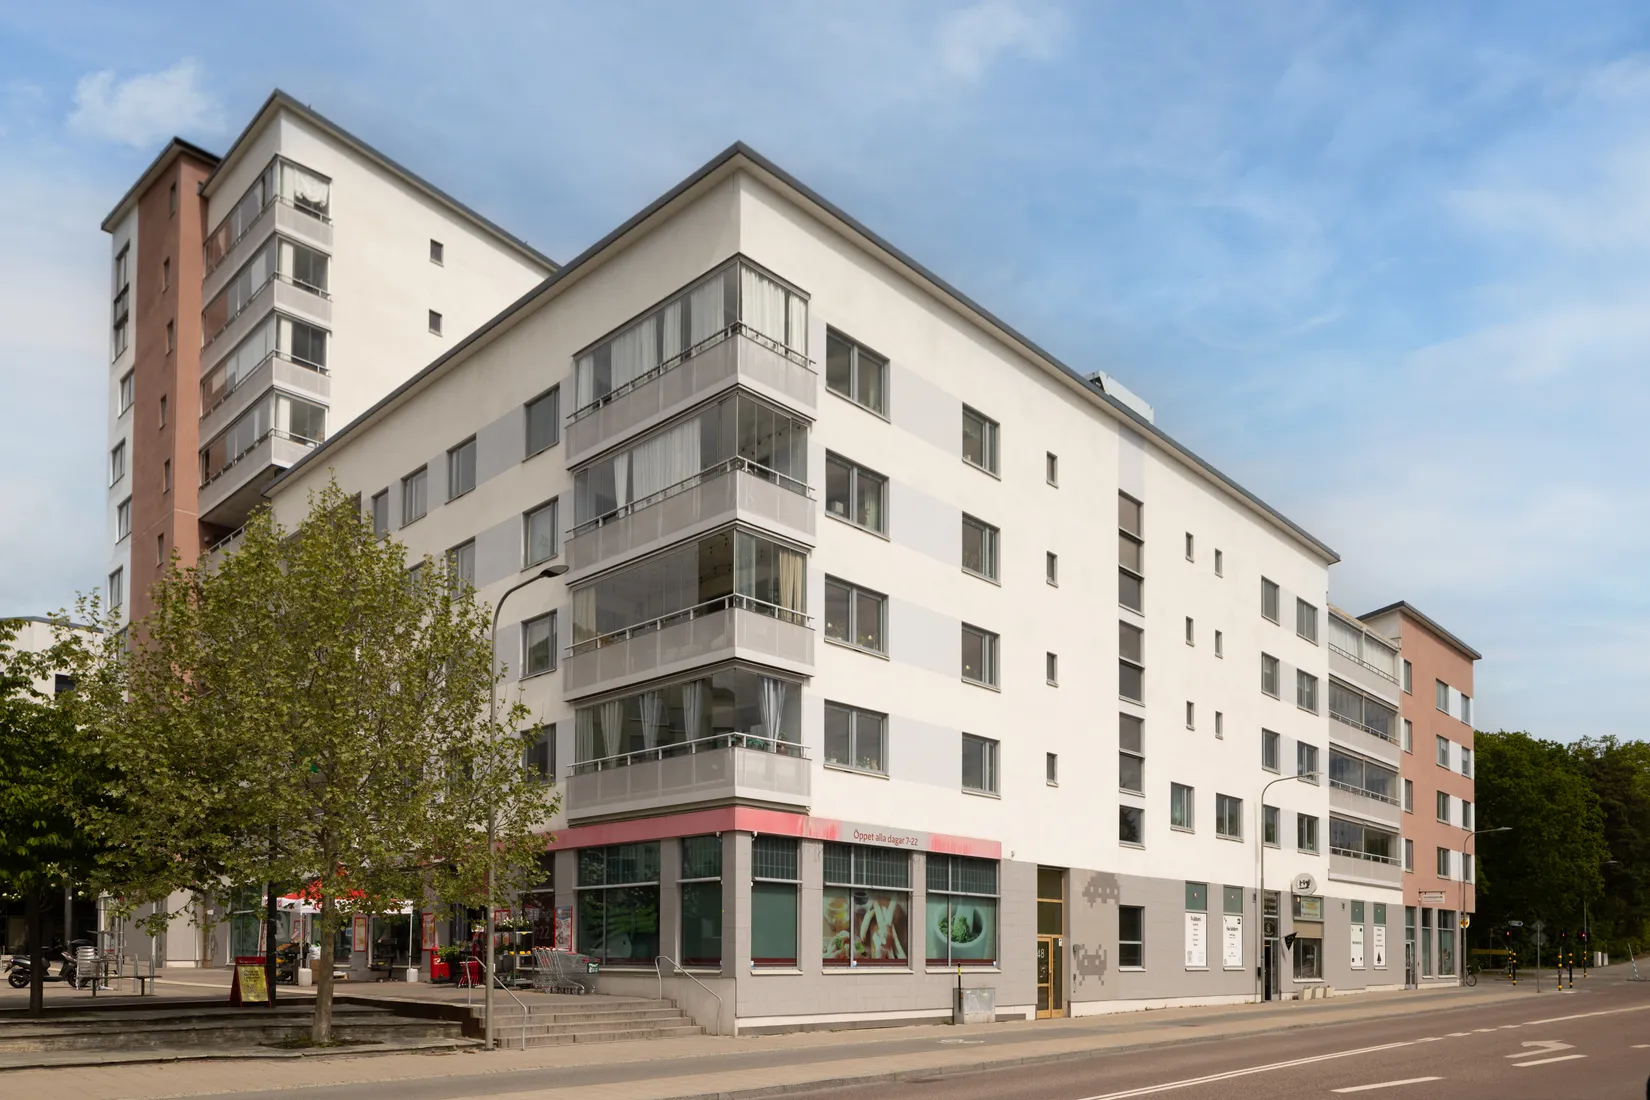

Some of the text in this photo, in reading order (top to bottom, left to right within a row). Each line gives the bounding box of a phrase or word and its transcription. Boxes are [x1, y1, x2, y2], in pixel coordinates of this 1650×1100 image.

[853, 829, 919, 846] Öppet alla dagar 7-22
[1037, 948, 1045, 958] 48
